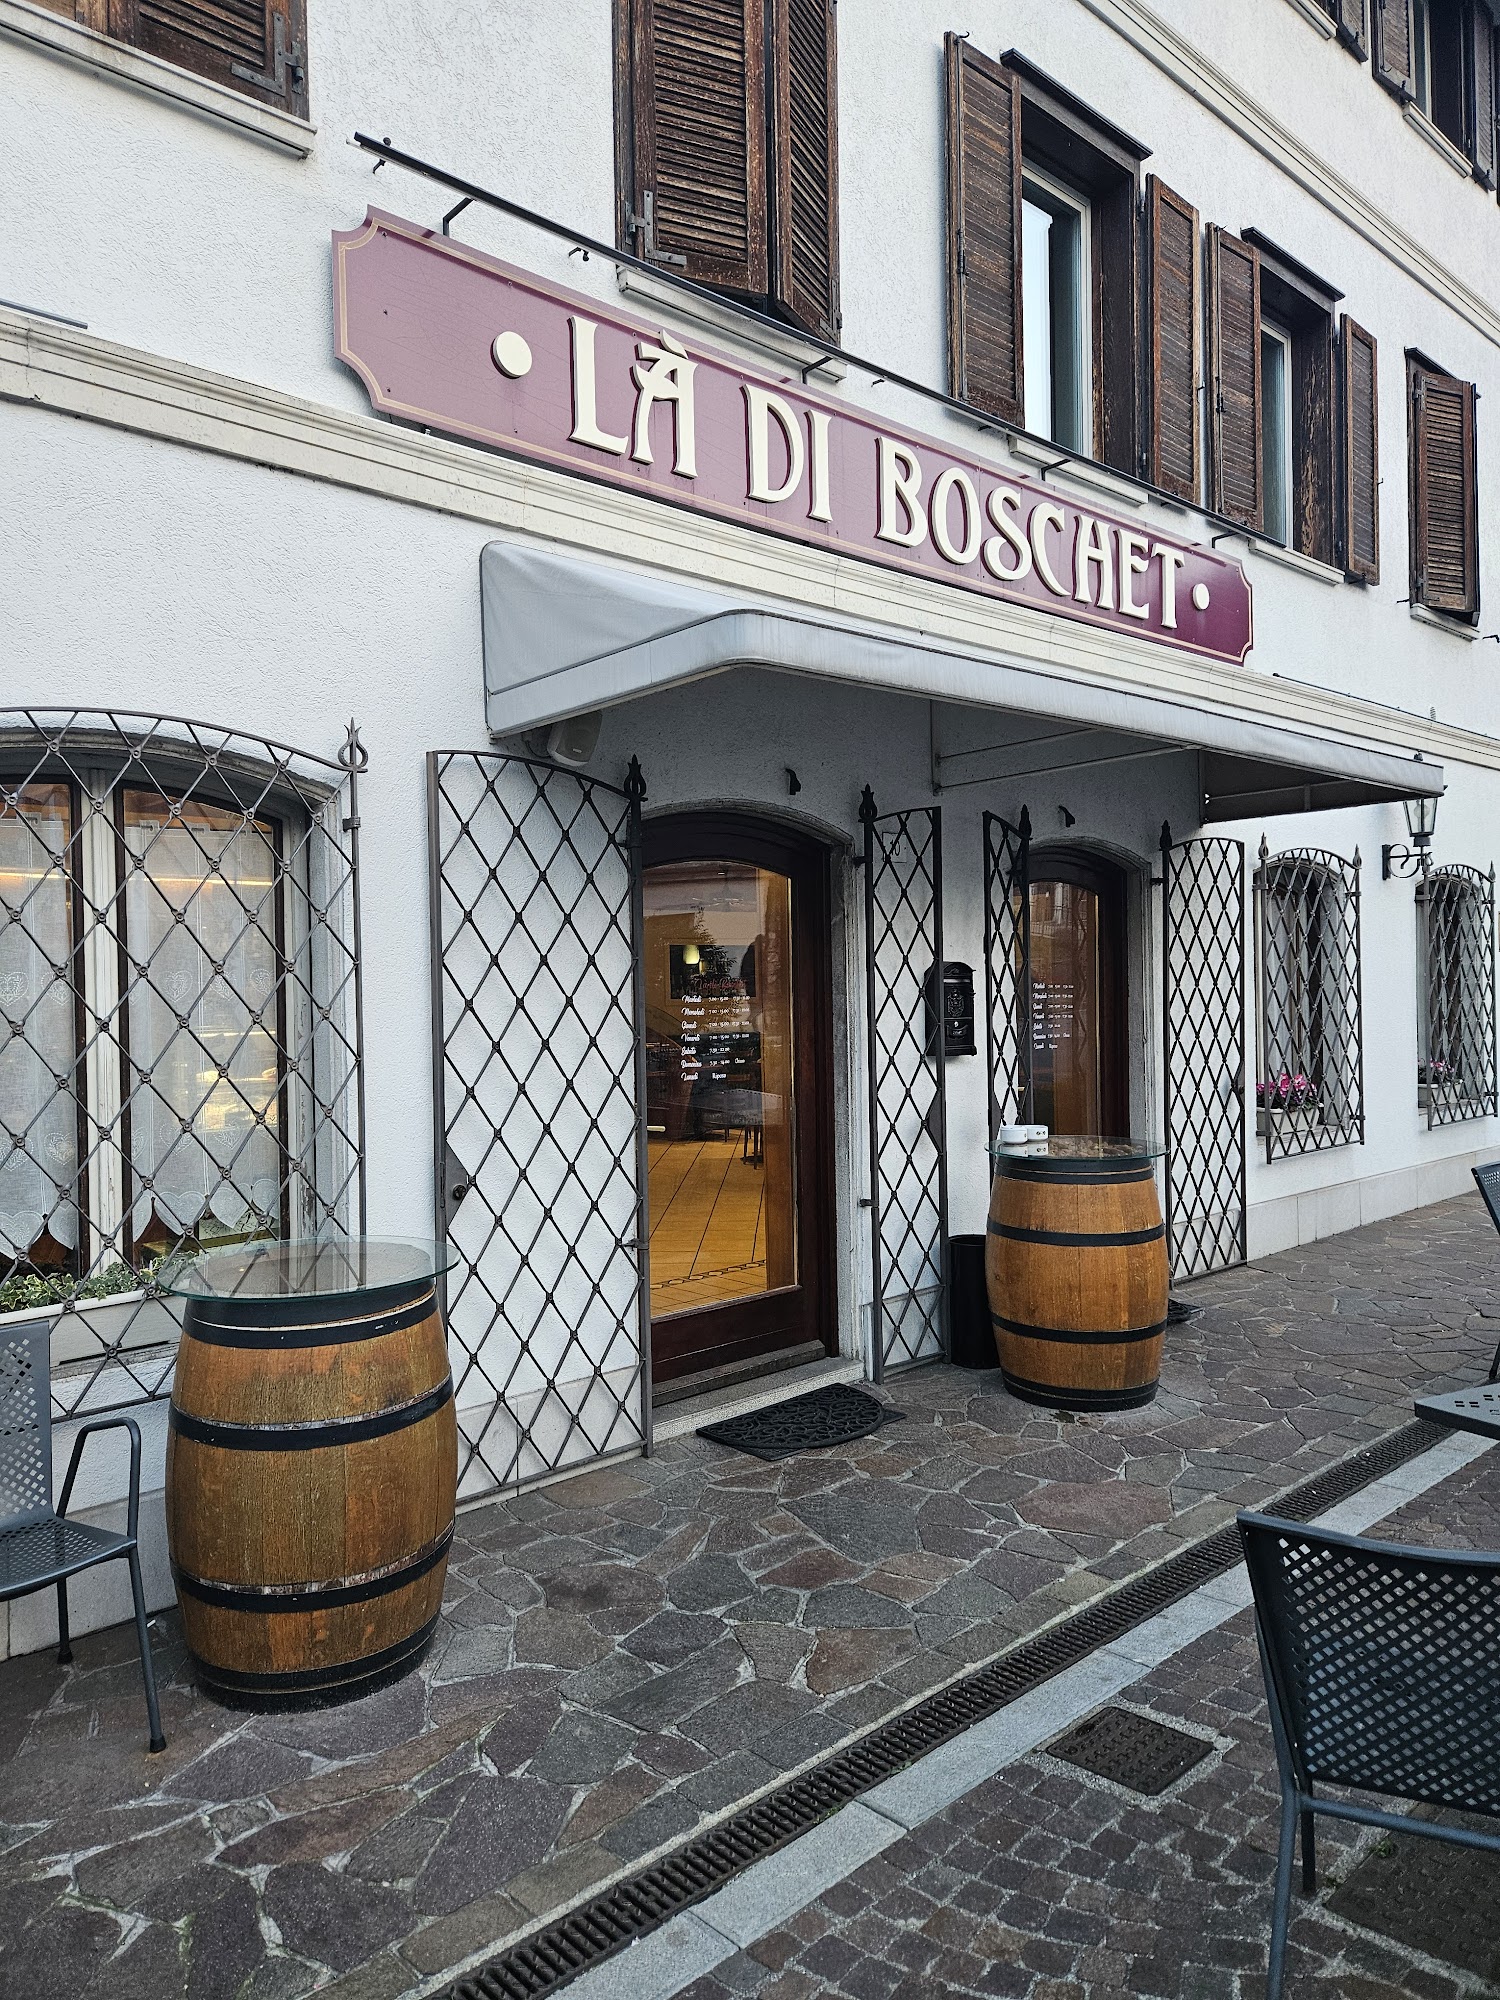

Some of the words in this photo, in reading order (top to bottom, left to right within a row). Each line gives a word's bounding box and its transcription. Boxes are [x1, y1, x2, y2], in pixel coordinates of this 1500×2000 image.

[567, 315, 699, 479] LÀ
[743, 384, 835, 523] DI
[875, 436, 1186, 629] BOSCHET
